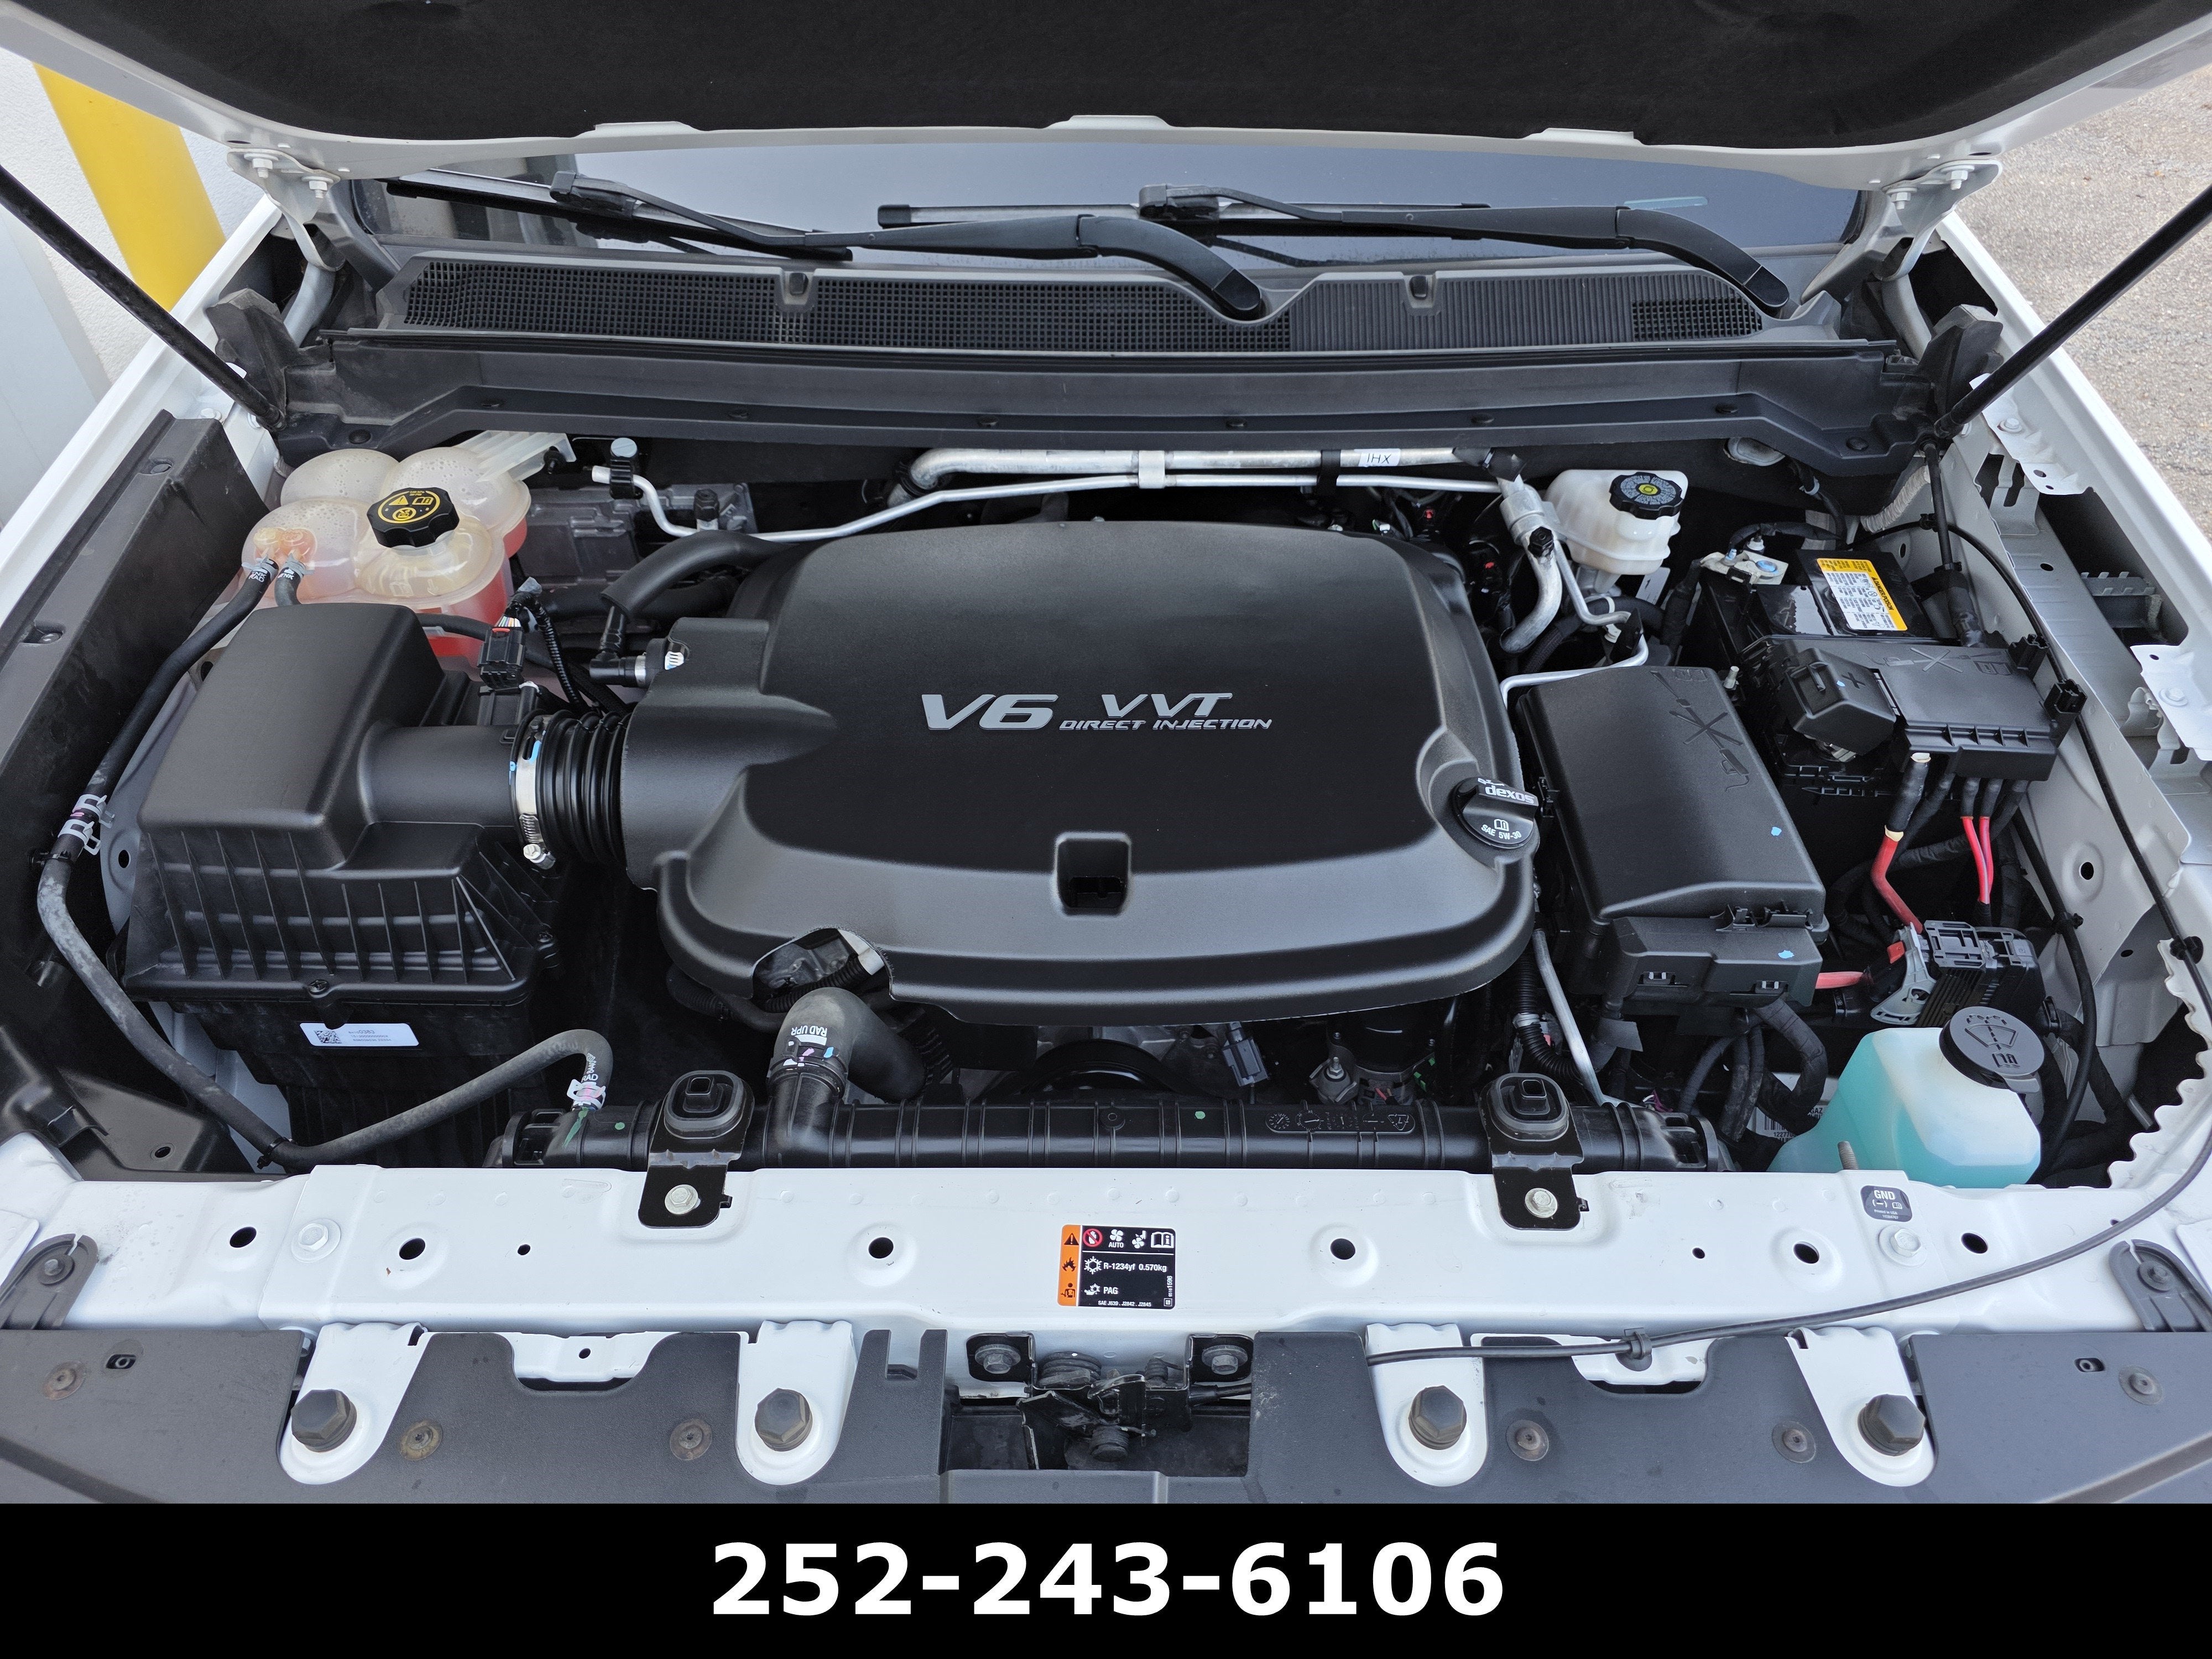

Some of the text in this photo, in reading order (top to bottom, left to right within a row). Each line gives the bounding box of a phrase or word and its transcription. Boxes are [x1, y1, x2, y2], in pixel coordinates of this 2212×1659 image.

[1101, 692, 1233, 718] VVT
[921, 693, 1058, 730] V6
[1058, 719, 1272, 731] DIRECT INJECTION
[1485, 785, 1535, 804] dexos
[1481, 824, 1522, 840] SAE 5W-30
[791, 1025, 828, 1037] RAD UPR
[581, 1073, 599, 1083] RAD
[1874, 1190, 1896, 1200] GND
[1103, 1262, 1167, 1272] R-1234yf 0.570kg
[1103, 1286, 1119, 1295] PAG
